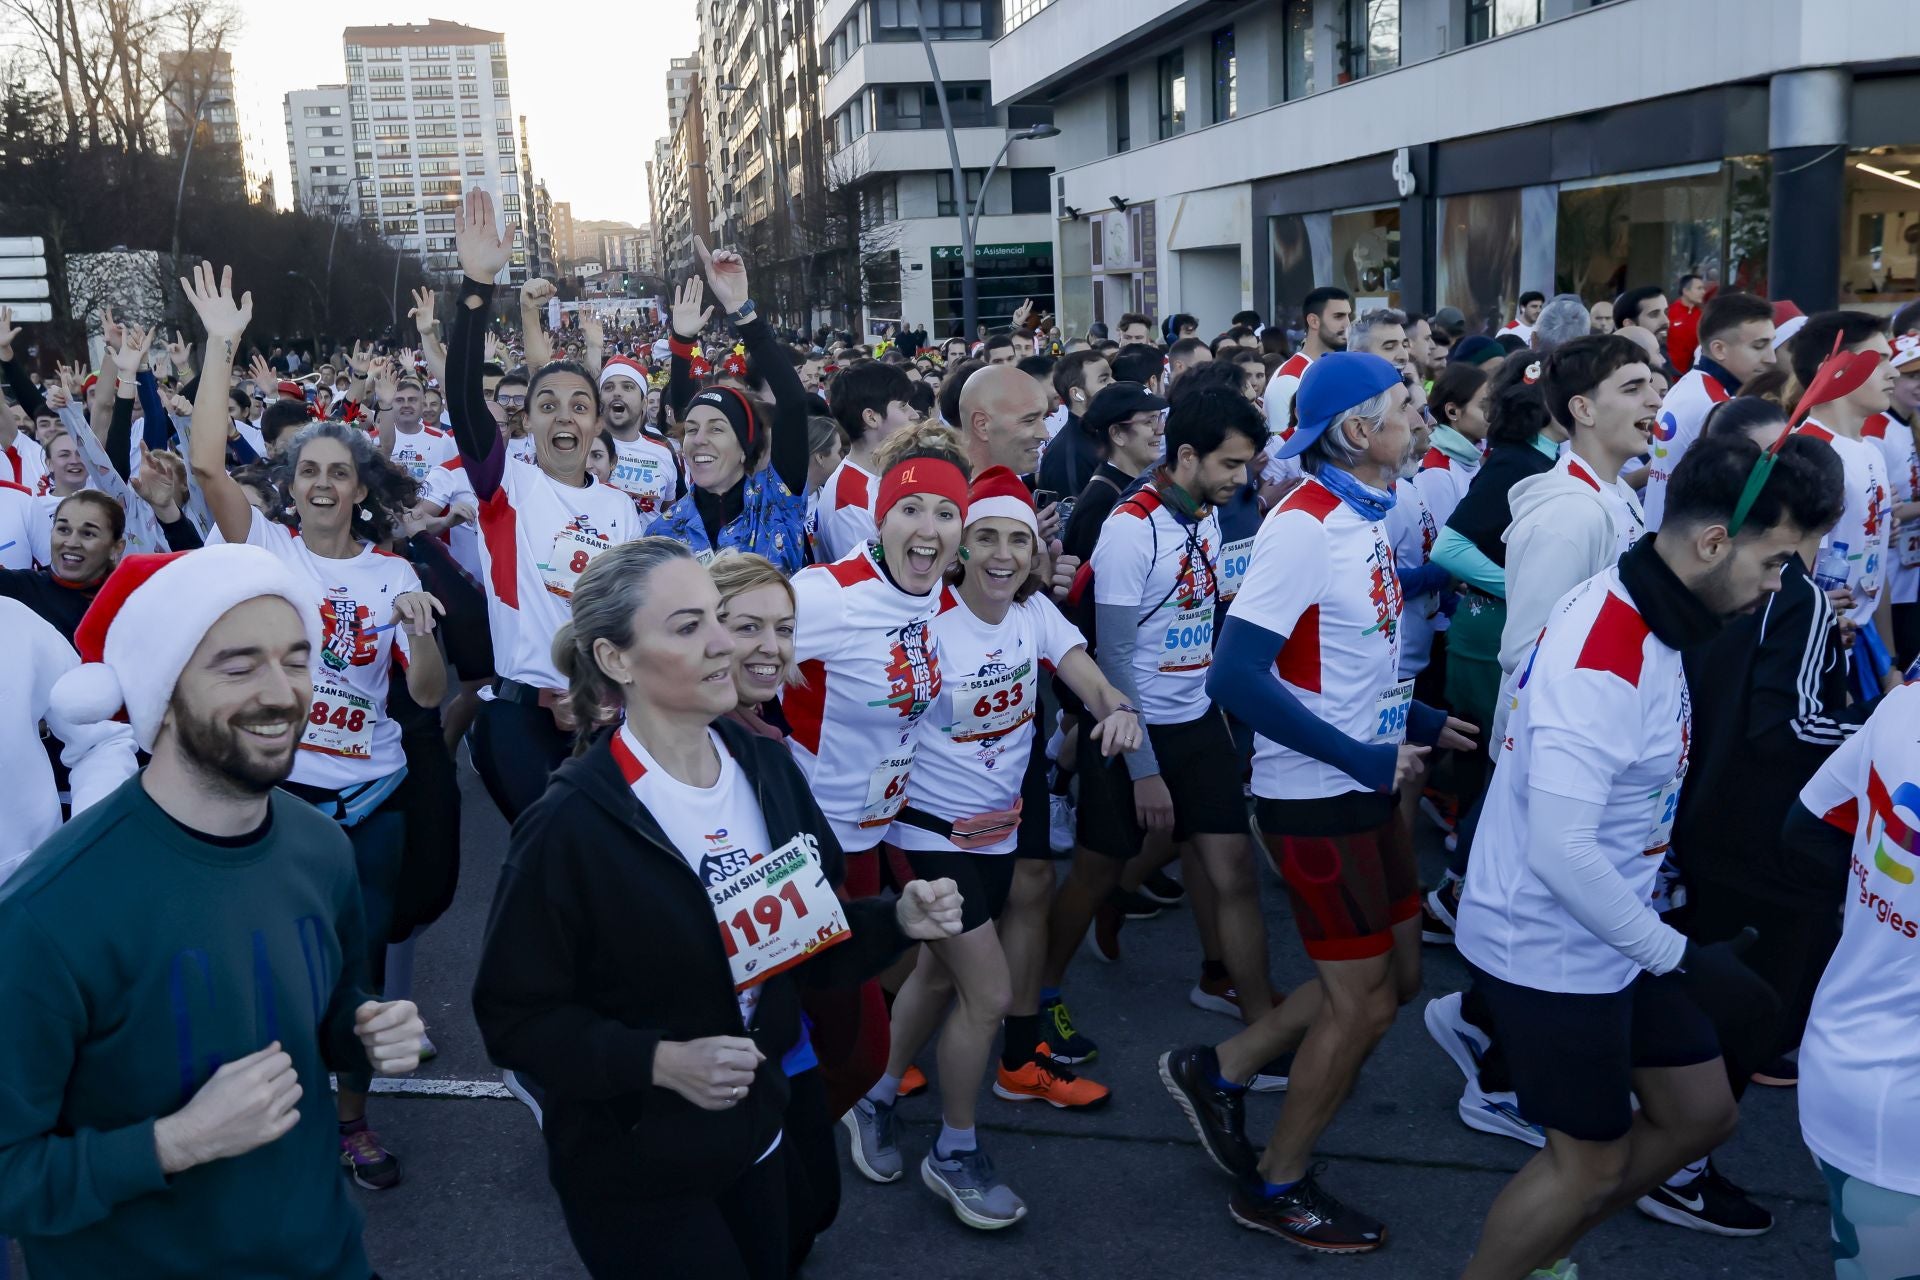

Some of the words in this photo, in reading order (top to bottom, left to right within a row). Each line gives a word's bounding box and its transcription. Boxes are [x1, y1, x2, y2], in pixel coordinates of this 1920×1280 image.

[954, 247, 981, 257] Ceo
[983, 244, 1025, 255] Asistencial
[617, 464, 653, 483] 3775
[574, 534, 586, 543] 55
[586, 537, 602, 549] SAN
[335, 601, 356, 613] 55
[336, 612, 355, 622] AN
[903, 631, 922, 649] SAN
[1164, 622, 1211, 650] 5000
[906, 648, 926, 667] SIL
[912, 663, 930, 683] VES
[912, 681, 932, 701] TRE
[970, 680, 982, 690] 55
[983, 677, 1000, 688] SAN
[319, 686, 338, 696] SAN
[337, 689, 371, 706] SILVESTRE
[973, 682, 1024, 718] 633
[309, 701, 366, 733] 848
[890, 759, 900, 767] 55
[720, 850, 751, 876] 55
[714, 880, 742, 905] SAN
[740, 846, 802, 890] SILVESTRE
